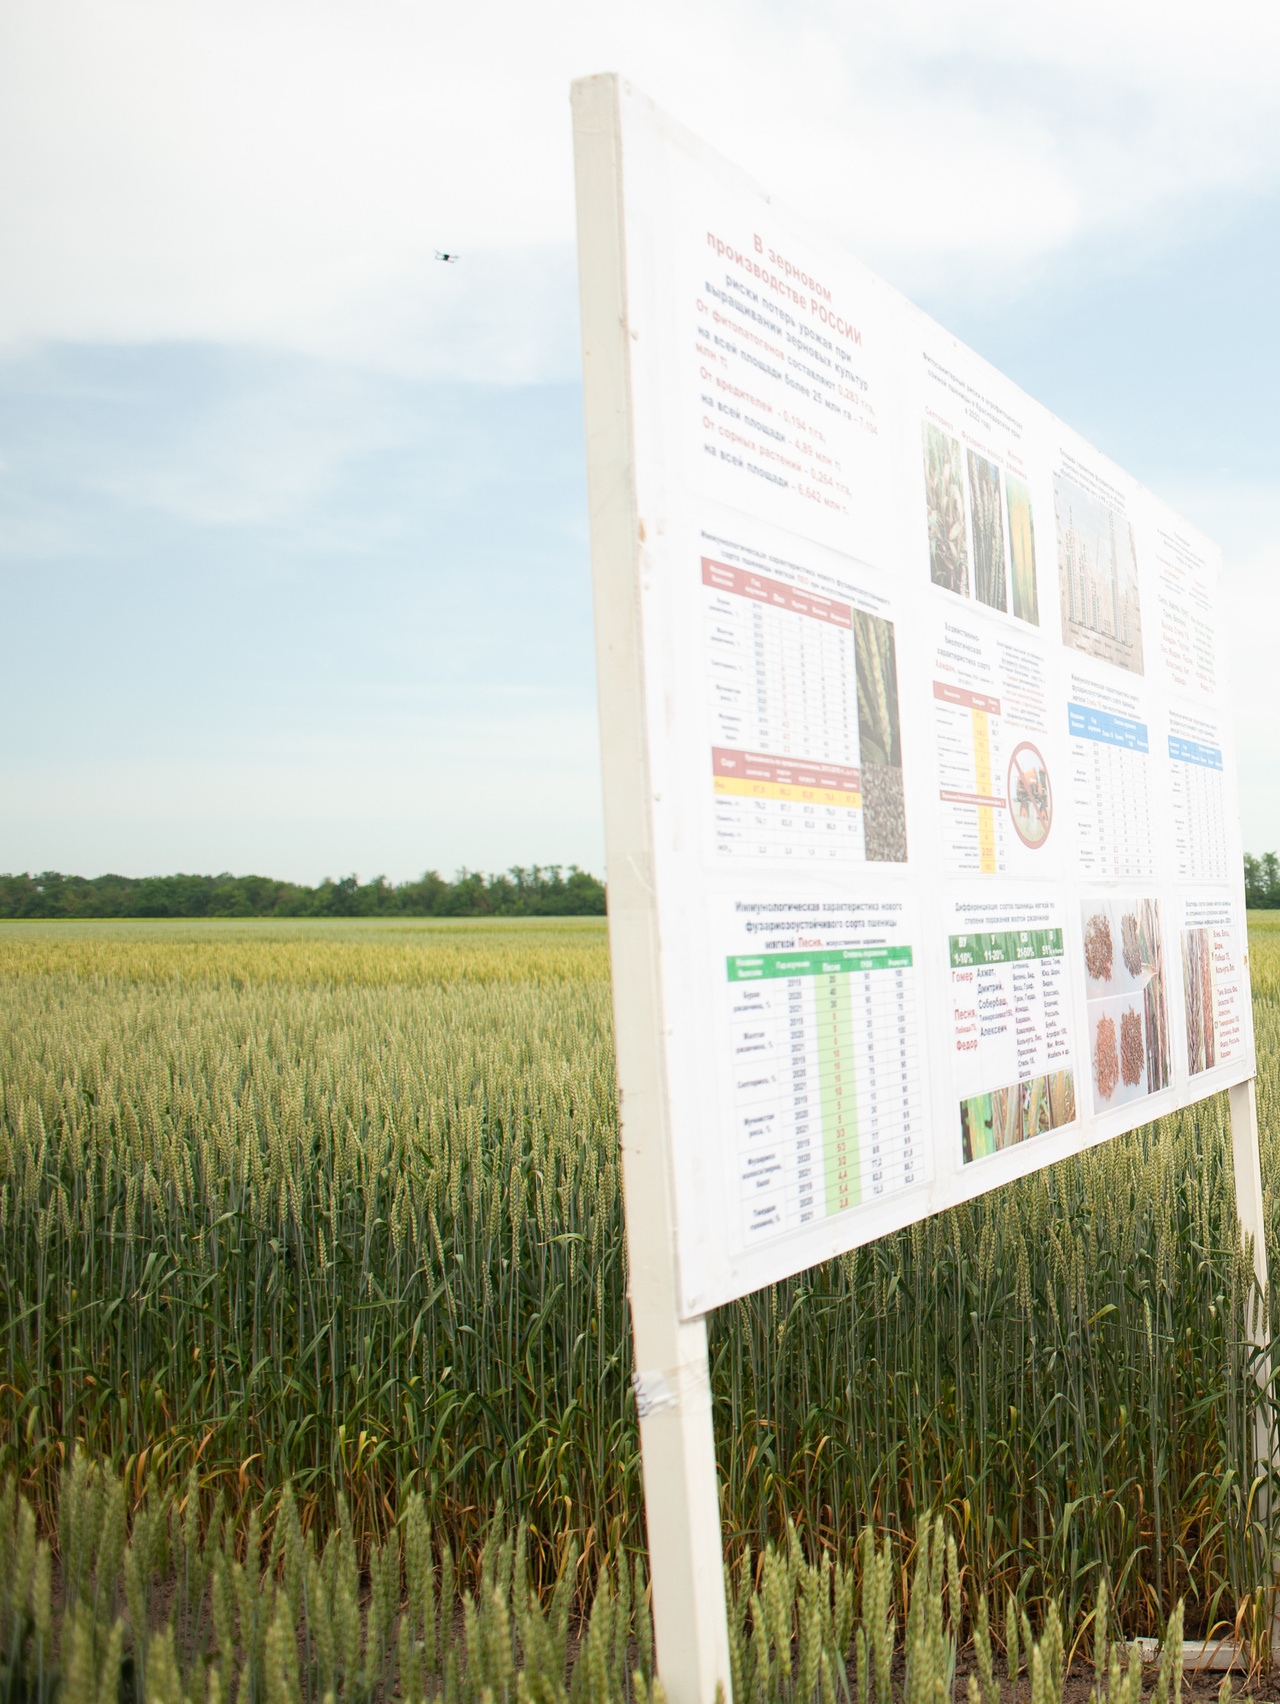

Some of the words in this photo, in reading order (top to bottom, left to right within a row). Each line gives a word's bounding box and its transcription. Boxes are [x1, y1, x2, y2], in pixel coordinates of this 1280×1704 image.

[707, 233, 805, 308] производстве
[811, 299, 861, 344] РОССИИ
[753, 232, 763, 256] В
[769, 249, 830, 301] зерновом
[695, 343, 716, 359] млн
[696, 298, 708, 313] От
[712, 310, 784, 359] фитопатогенов
[788, 356, 834, 388] составляют
[705, 282, 781, 334] выращивании
[786, 332, 830, 366] зерновых
[835, 364, 867, 390] культур
[726, 275, 758, 301] риски
[762, 298, 795, 326] потерь
[799, 323, 832, 350] урожая
[836, 346, 851, 361] при
[698, 326, 710, 339] на
[714, 335, 737, 353] всей
[741, 351, 781, 379] площади
[785, 373, 809, 396] более
[813, 390, 821, 403] 25
[825, 400, 840, 413] млн
[700, 366, 711, 380] От
[716, 378, 771, 412] вредителей
[701, 394, 713, 406] на
[717, 402, 740, 419] всей
[744, 416, 785, 441] площади
[815, 452, 831, 464] млн
[703, 416, 714, 429] От
[718, 426, 755, 449] сорных
[759, 446, 801, 471] растений
[704, 444, 716, 456] на
[720, 451, 743, 466] всей
[747, 463, 788, 487] площади
[824, 498, 840, 510] млн
[736, 902, 819, 913] Иммунологическая
[823, 903, 878, 912] характеристика
[845, 920, 864, 928] сорта
[952, 971, 972, 982] Гомер
[956, 1039, 977, 1050] Федор
